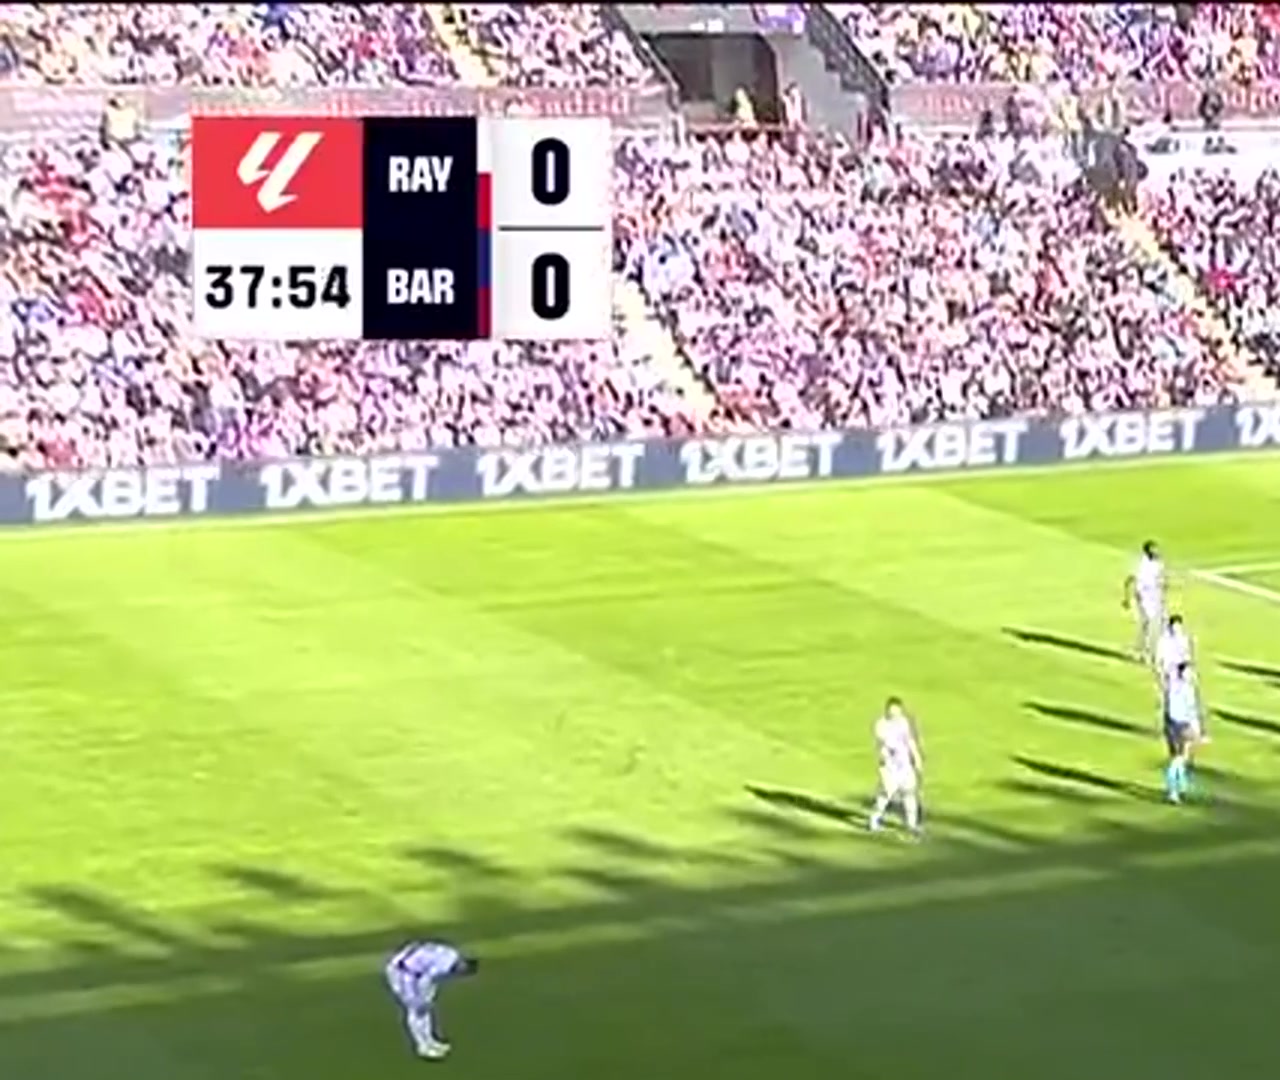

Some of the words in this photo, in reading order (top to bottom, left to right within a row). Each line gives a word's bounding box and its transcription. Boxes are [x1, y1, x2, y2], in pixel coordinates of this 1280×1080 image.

[25, 466, 220, 519] 1XBET
[258, 454, 439, 507] 1XBET
[475, 444, 646, 495] 1XBET
[679, 434, 842, 484] 1XBET
[876, 421, 1027, 471] 1XBET
[1059, 411, 1206, 460] 1XBET
